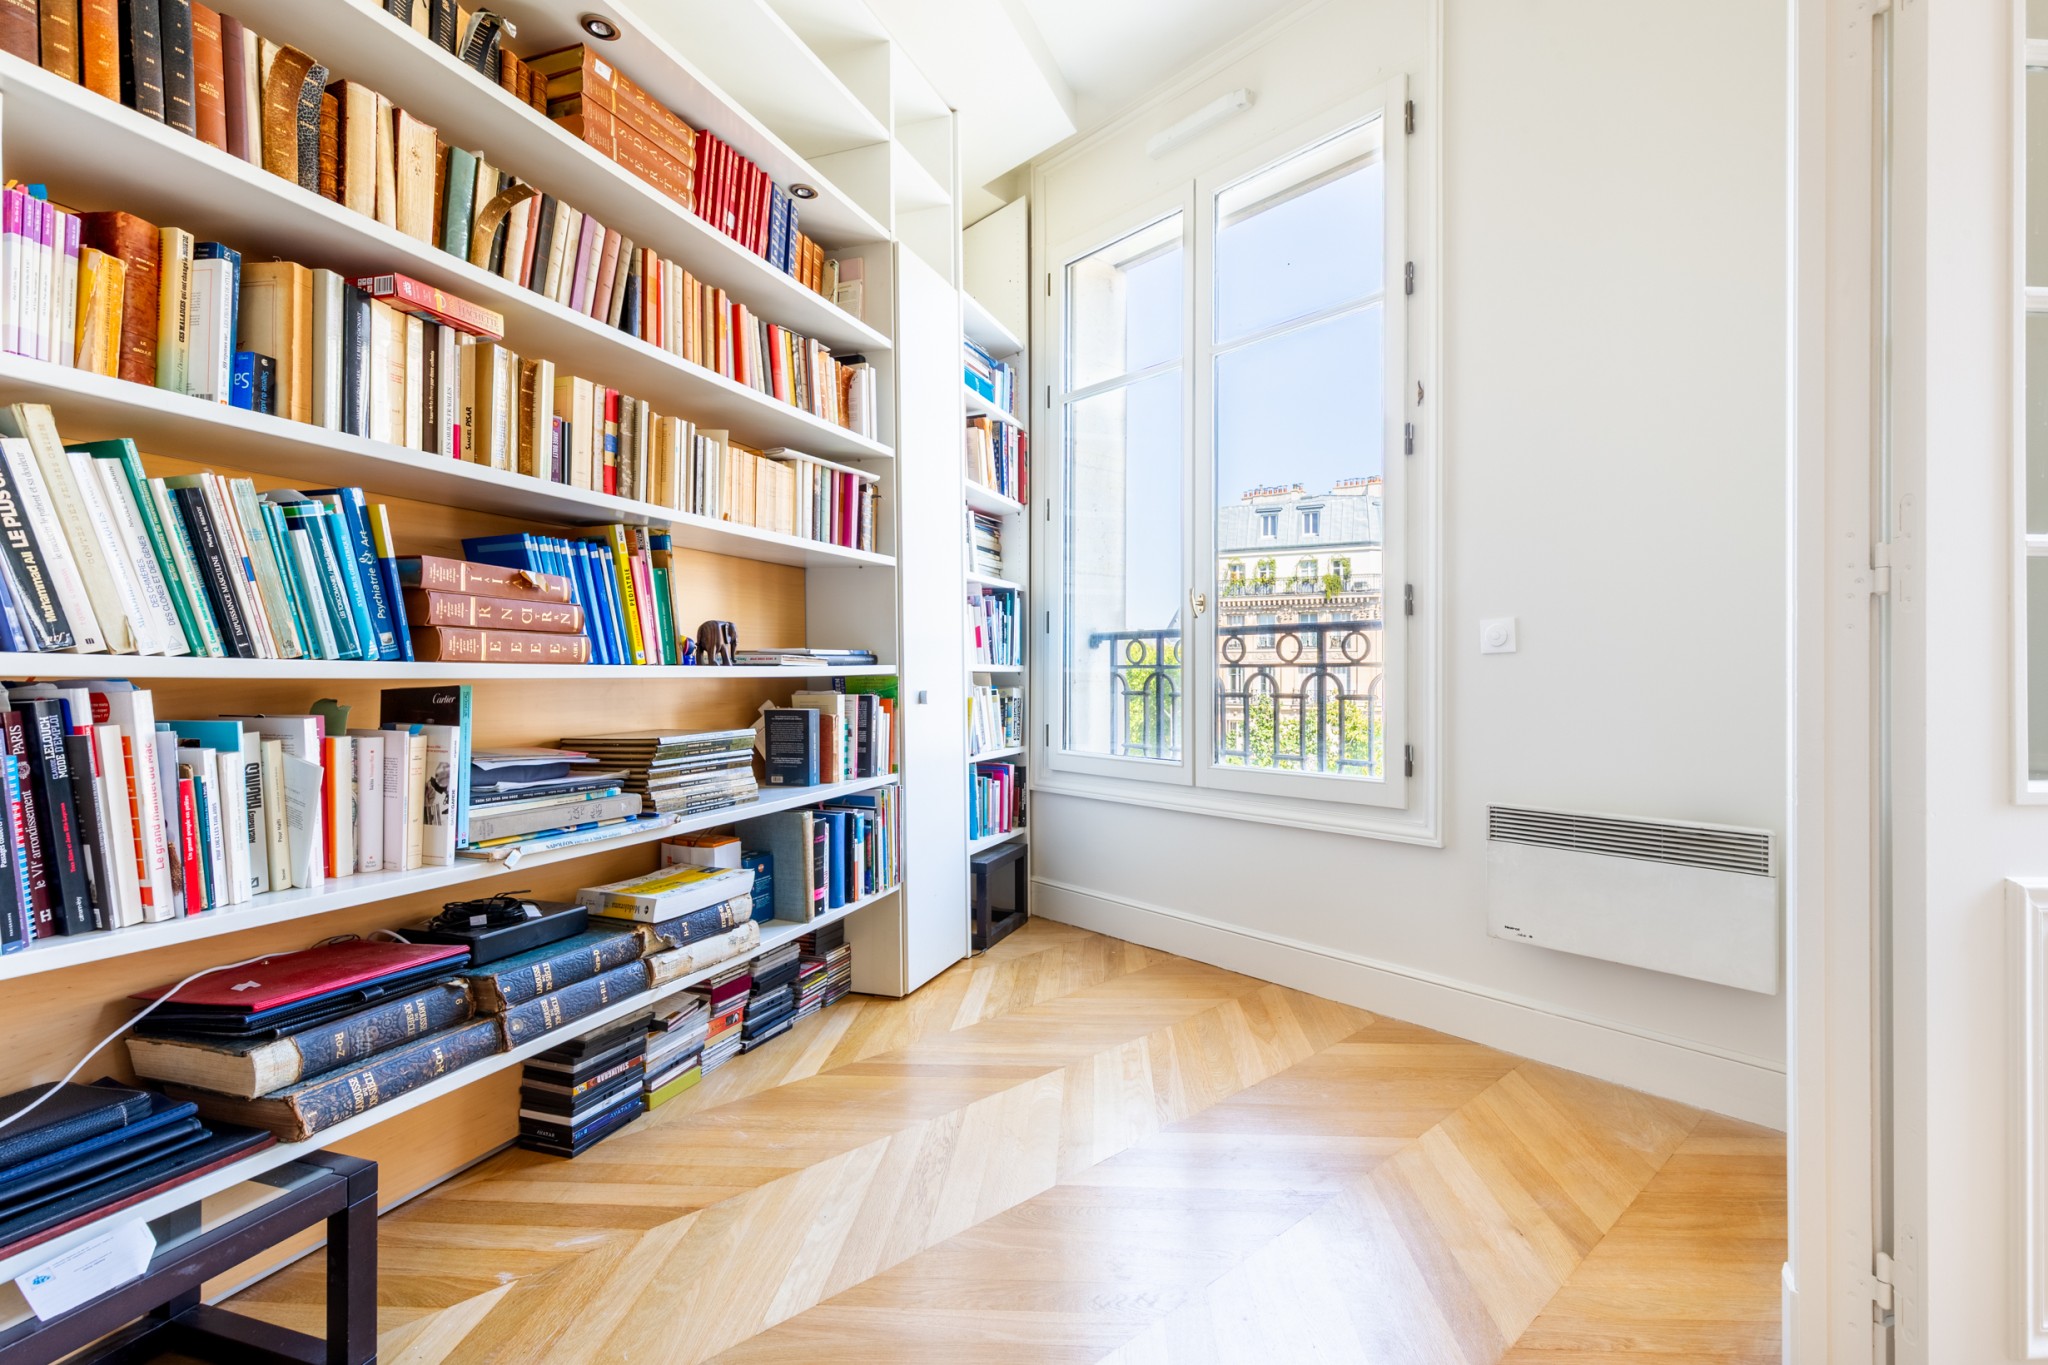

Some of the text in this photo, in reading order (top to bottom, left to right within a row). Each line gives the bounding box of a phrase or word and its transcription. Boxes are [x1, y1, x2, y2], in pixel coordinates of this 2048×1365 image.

[28, 564, 58, 622] Muhammad
[211, 555, 243, 637] IMPUISSANCE MASCULINE
[369, 566, 386, 620] Psychiatrie
[623, 567, 636, 607] PEDIATRIE
[432, 692, 456, 705] Cartier
[12, 724, 26, 755] PARIS
[40, 716, 55, 761] LELOUCH
[49, 714, 69, 778] MODE D'EMPLOI
[24, 789, 42, 861] arrondissement
[152, 823, 167, 856] grand
[155, 856, 166, 872] Le
[532, 965, 543, 995] LAROUSSE
[415, 998, 428, 1033] LAROUSSE
[455, 998, 462, 1006] 6
[540, 999, 552, 1030] LAROUSSE
[596, 1061, 630, 1083] STALINGRAD
[349, 1076, 365, 1113] LAROUSSE
[609, 1103, 633, 1119] AVATAR
